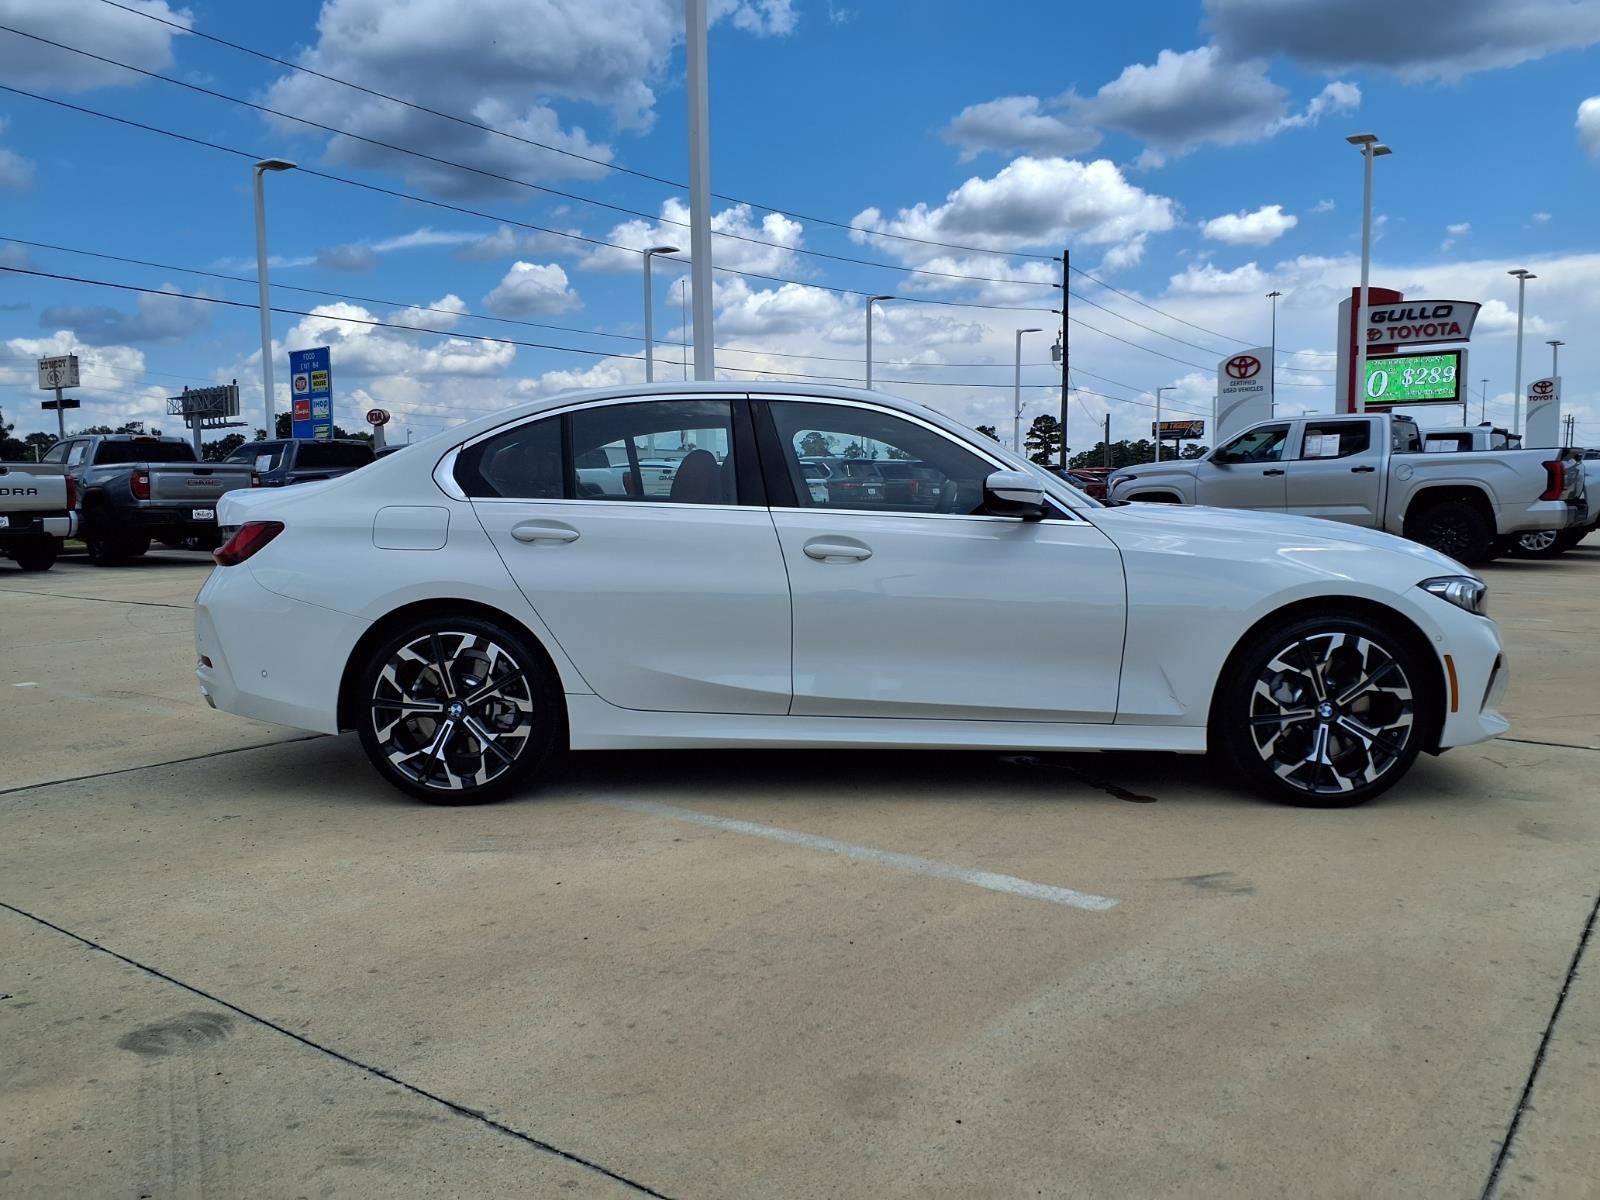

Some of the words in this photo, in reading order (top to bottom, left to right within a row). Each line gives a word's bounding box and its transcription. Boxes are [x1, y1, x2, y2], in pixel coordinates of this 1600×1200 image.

[1370, 305, 1453, 323] GULLO
[1387, 322, 1461, 339] TOYOTA
[41, 359, 66, 370] COWBOY
[1402, 366, 1456, 388] $289
[369, 412, 382, 421] KIA
